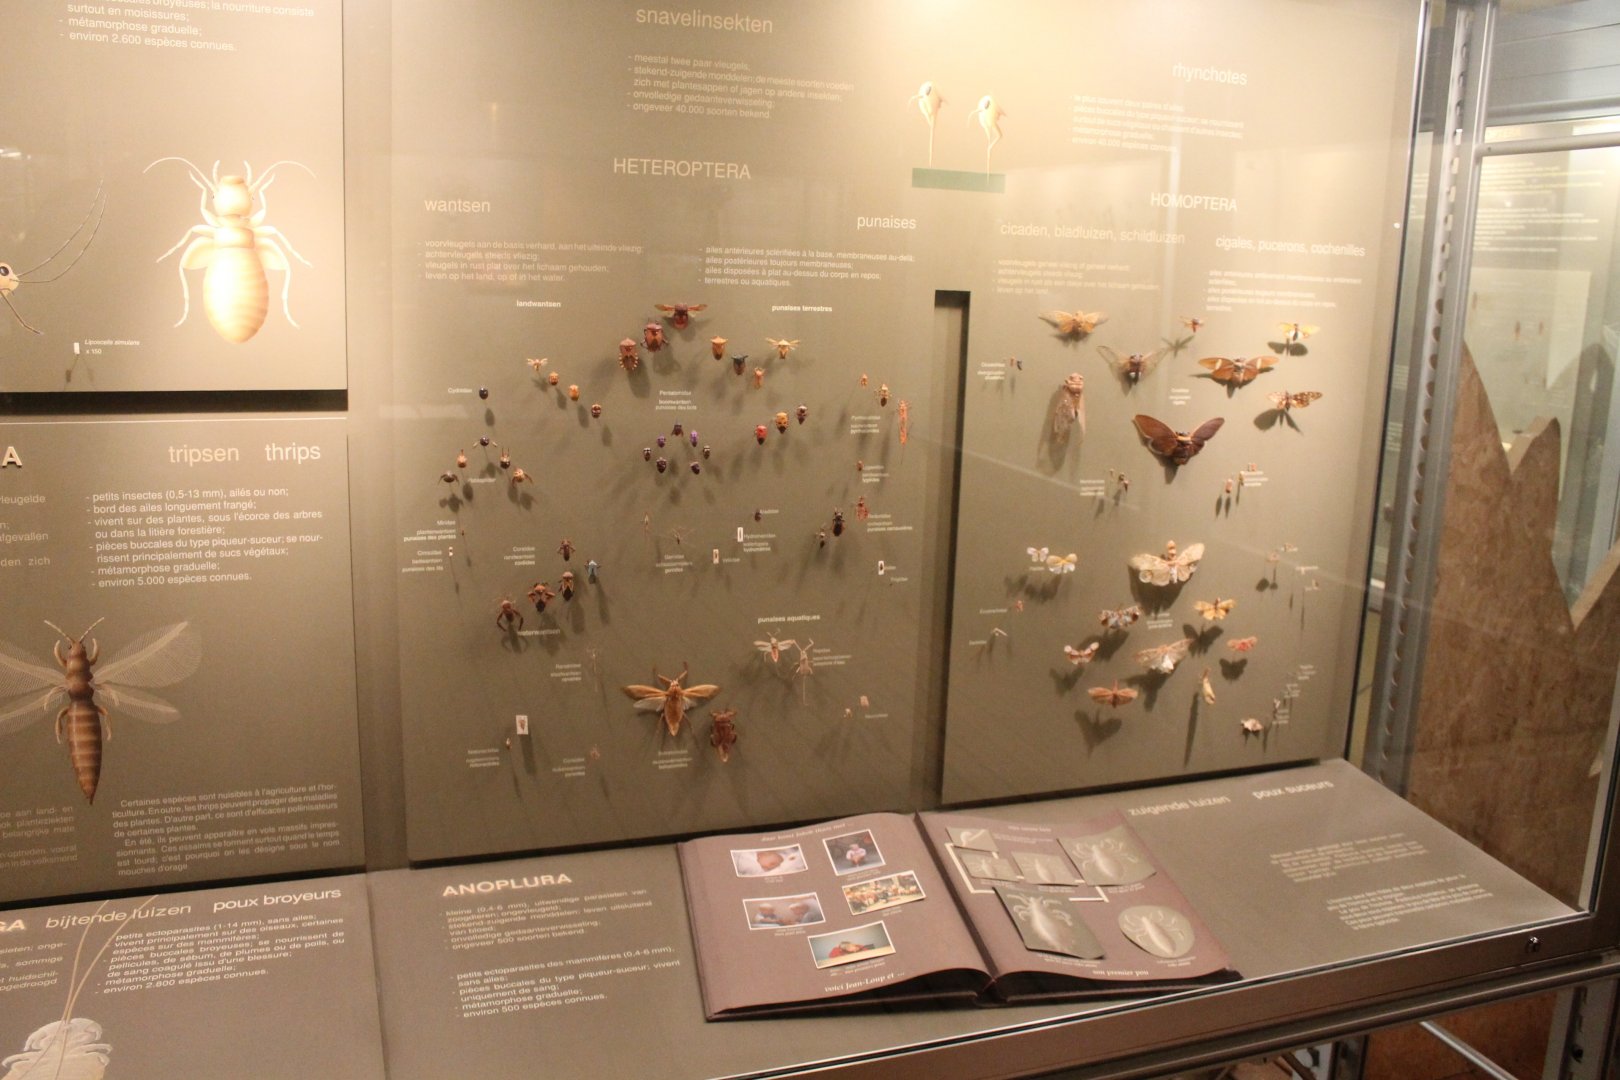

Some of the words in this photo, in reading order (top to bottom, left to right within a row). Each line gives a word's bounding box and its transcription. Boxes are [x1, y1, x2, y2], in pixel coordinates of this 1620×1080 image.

[67, 7, 105, 15] surtout
[125, 9, 189, 22] moisissures;
[211, 1, 221, 10] la
[222, 3, 272, 13] nourriture
[273, 7, 314, 16] consiste
[68, 18, 148, 31] métamorphose
[151, 24, 202, 36] graduelle;
[636, 8, 772, 33] snavelinsekten
[69, 32, 109, 42] environ
[111, 34, 142, 45] 2.600
[145, 37, 188, 48] espèces
[190, 42, 237, 51] connues.
[613, 157, 751, 179] HETEROPTERA
[425, 199, 491, 212] wantsen
[1150, 192, 1238, 212] HOMOPTERA
[857, 215, 916, 230] punaises
[1000, 222, 1050, 239] cicaden,
[1054, 225, 1117, 242] bladluizen,
[1120, 228, 1185, 245] schildluizen
[1215, 234, 1256, 251] cigales,
[1311, 240, 1365, 257] cochenilles
[168, 445, 239, 466] tripsen
[265, 443, 321, 464] thrips
[92, 491, 120, 503] petits
[122, 491, 163, 500] insectes
[229, 488, 251, 497] ailés
[268, 489, 289, 497] non;
[93, 503, 116, 513] bord
[118, 503, 137, 512] des
[140, 503, 162, 512] ailes
[164, 502, 221, 513] longuement
[223, 500, 257, 512] frangé;
[94, 517, 124, 526] vivent
[146, 515, 164, 524] des
[234, 512, 270, 521] l'écorce
[273, 511, 290, 520] des
[293, 510, 323, 519] arbres
[110, 529, 134, 538] dans
[136, 528, 147, 537] la
[149, 527, 175, 537] litière
[177, 526, 225, 536] forestière;
[96, 540, 127, 552] pièces
[130, 538, 173, 548] buccales
[175, 538, 188, 547] du
[189, 539, 210, 549] type
[28, 556, 51, 566] zich
[97, 553, 130, 563] rissent
[132, 551, 202, 564] principalement
[204, 549, 217, 559] de
[97, 564, 170, 576] métamorphose
[173, 561, 220, 574] graduelle;
[98, 577, 135, 587] environ
[137, 575, 165, 585] 5.000
[167, 574, 207, 586] espèces
[209, 574, 252, 582] connues.
[442, 873, 573, 897] ANOPLURA
[213, 896, 258, 913] poux
[263, 888, 341, 906] broyeurs
[45, 910, 127, 929] bijtende
[132, 904, 191, 919] luizen
[110, 954, 144, 964] pièces
[150, 948, 195, 958] buccales
[275, 933, 327, 945] nourrissent
[107, 970, 119, 978] de
[121, 968, 150, 976] sang
[151, 961, 192, 973] coagulé
[103, 984, 143, 993] environ
[178, 975, 220, 985] espèces
[105, 972, 183, 985] métamorphose
[462, 996, 533, 1010] métamorphose
[463, 1007, 499, 1017] environ
[501, 1003, 520, 1012] 500
[522, 999, 562, 1010] espèces
